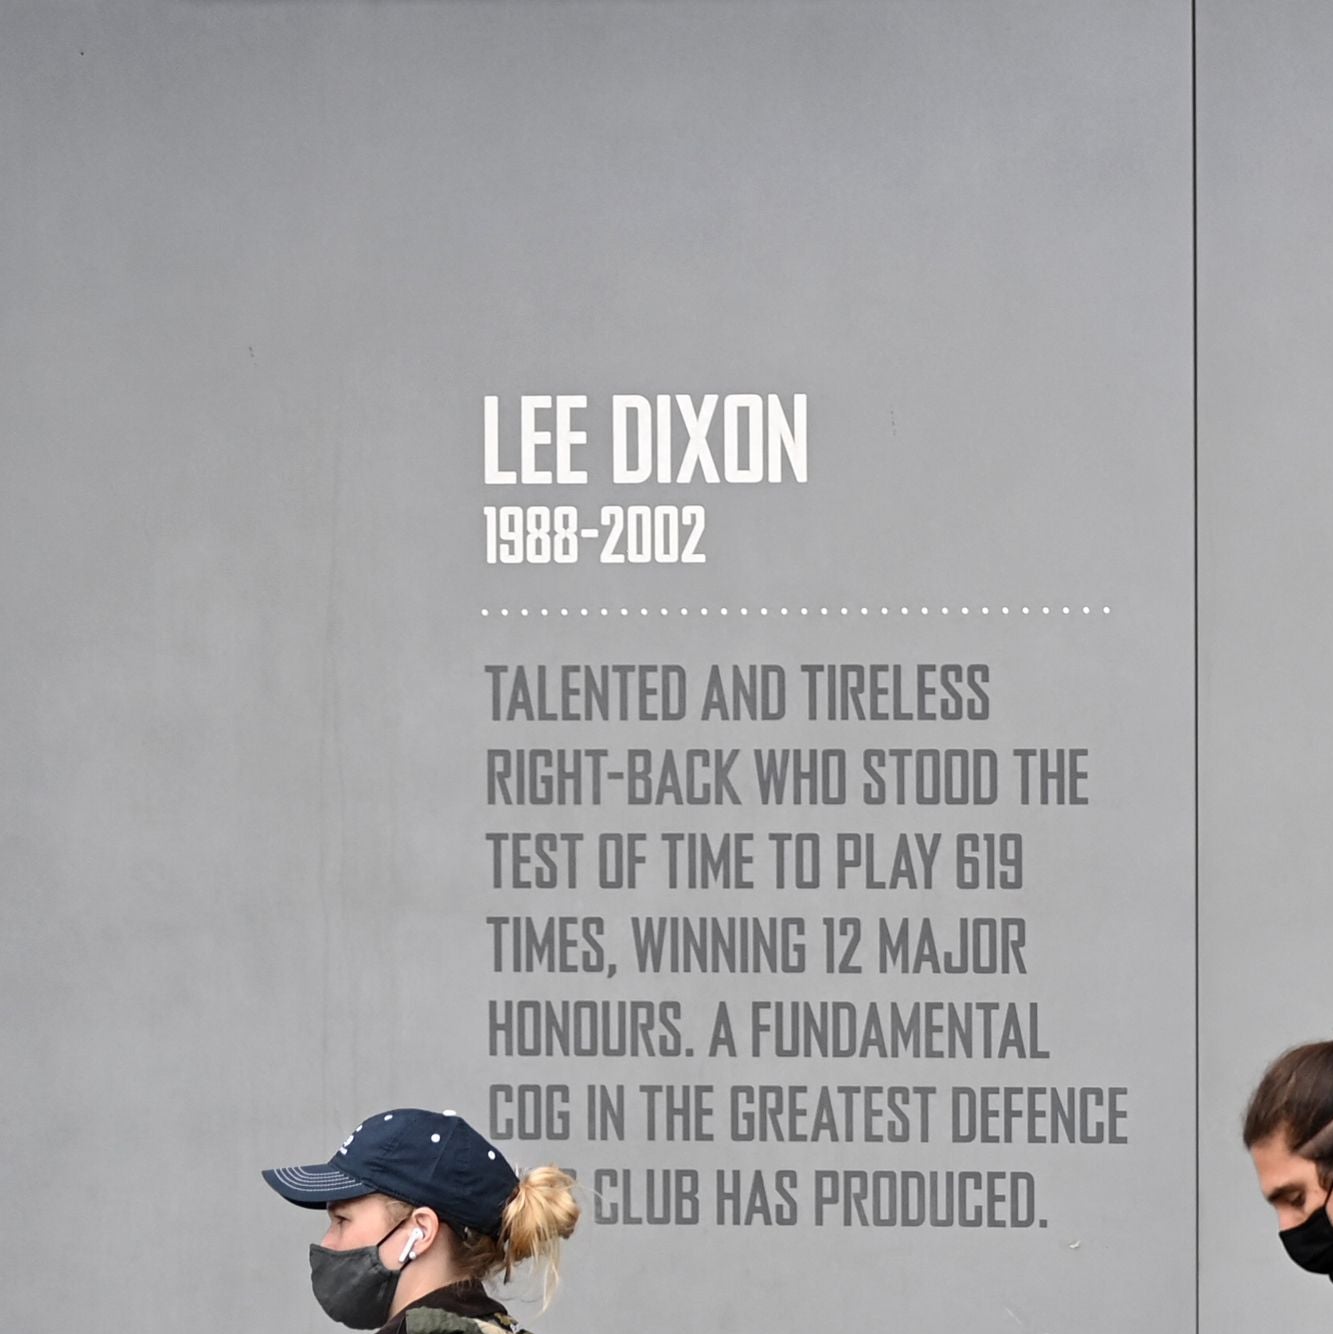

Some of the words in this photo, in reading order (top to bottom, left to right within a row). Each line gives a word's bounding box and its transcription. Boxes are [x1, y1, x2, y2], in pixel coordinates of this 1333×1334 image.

[485, 396, 587, 484] LEE
[613, 394, 807, 483] DIXON
[484, 506, 705, 563] 1988-2002
[485, 665, 686, 721] TALENTED
[701, 665, 785, 720] AND
[801, 664, 989, 720] TIRELESS
[487, 749, 742, 805] RIGHT-BACK
[754, 749, 846, 805] WHO
[864, 749, 997, 805] STOOD
[1013, 749, 1088, 805] THE
[486, 833, 583, 889] TEST
[599, 833, 646, 889] OF
[661, 833, 753, 889] TIME
[769, 833, 820, 889] TO
[837, 833, 941, 889] PLAY
[957, 833, 1022, 889] 619
[486, 917, 616, 978] TIMES,
[631, 917, 805, 973] WINNING
[823, 918, 862, 973] 12
[879, 918, 1027, 974] MAJOR
[489, 1000, 693, 1057] HONOURS.
[709, 1001, 737, 1057] A
[752, 1001, 1050, 1058] FUNDAMENTAL
[489, 1084, 569, 1140] COG
[588, 1085, 624, 1141] IN
[640, 1085, 714, 1141] THE
[731, 1086, 936, 1142] GREATEST
[952, 1087, 1128, 1144] DEFENCE
[595, 1169, 699, 1225] CLUB
[717, 1170, 797, 1226] HAS
[815, 1170, 1047, 1228] PRODUCED.
